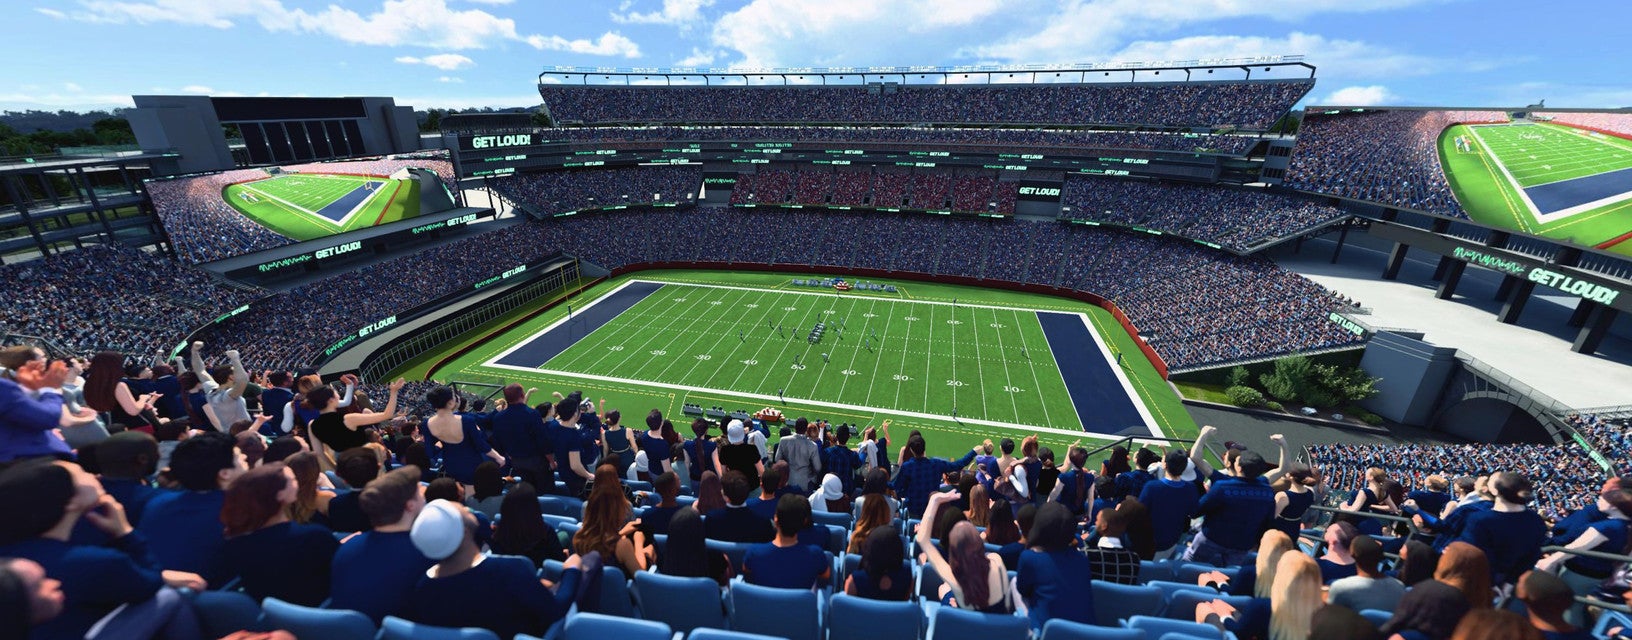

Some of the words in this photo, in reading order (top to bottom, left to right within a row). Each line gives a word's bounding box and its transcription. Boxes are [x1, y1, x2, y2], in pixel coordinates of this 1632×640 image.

[473, 136, 496, 149] GET
[496, 135, 531, 147] LOUD!
[1019, 186, 1036, 195] GET
[1035, 187, 1061, 197] LOUD!
[447, 218, 459, 227] GET
[459, 213, 478, 225] LOUD!
[315, 248, 334, 260] GET
[334, 240, 362, 256] LOUD!
[502, 271, 513, 280] GET
[512, 264, 527, 276] LOUD!
[1527, 267, 1566, 288] GET
[1559, 277, 1620, 305] LOUD!
[359, 326, 374, 338] GET
[373, 315, 397, 334] LOUD!
[1329, 312, 1345, 325] GET
[1341, 319, 1365, 336] LOUD!
